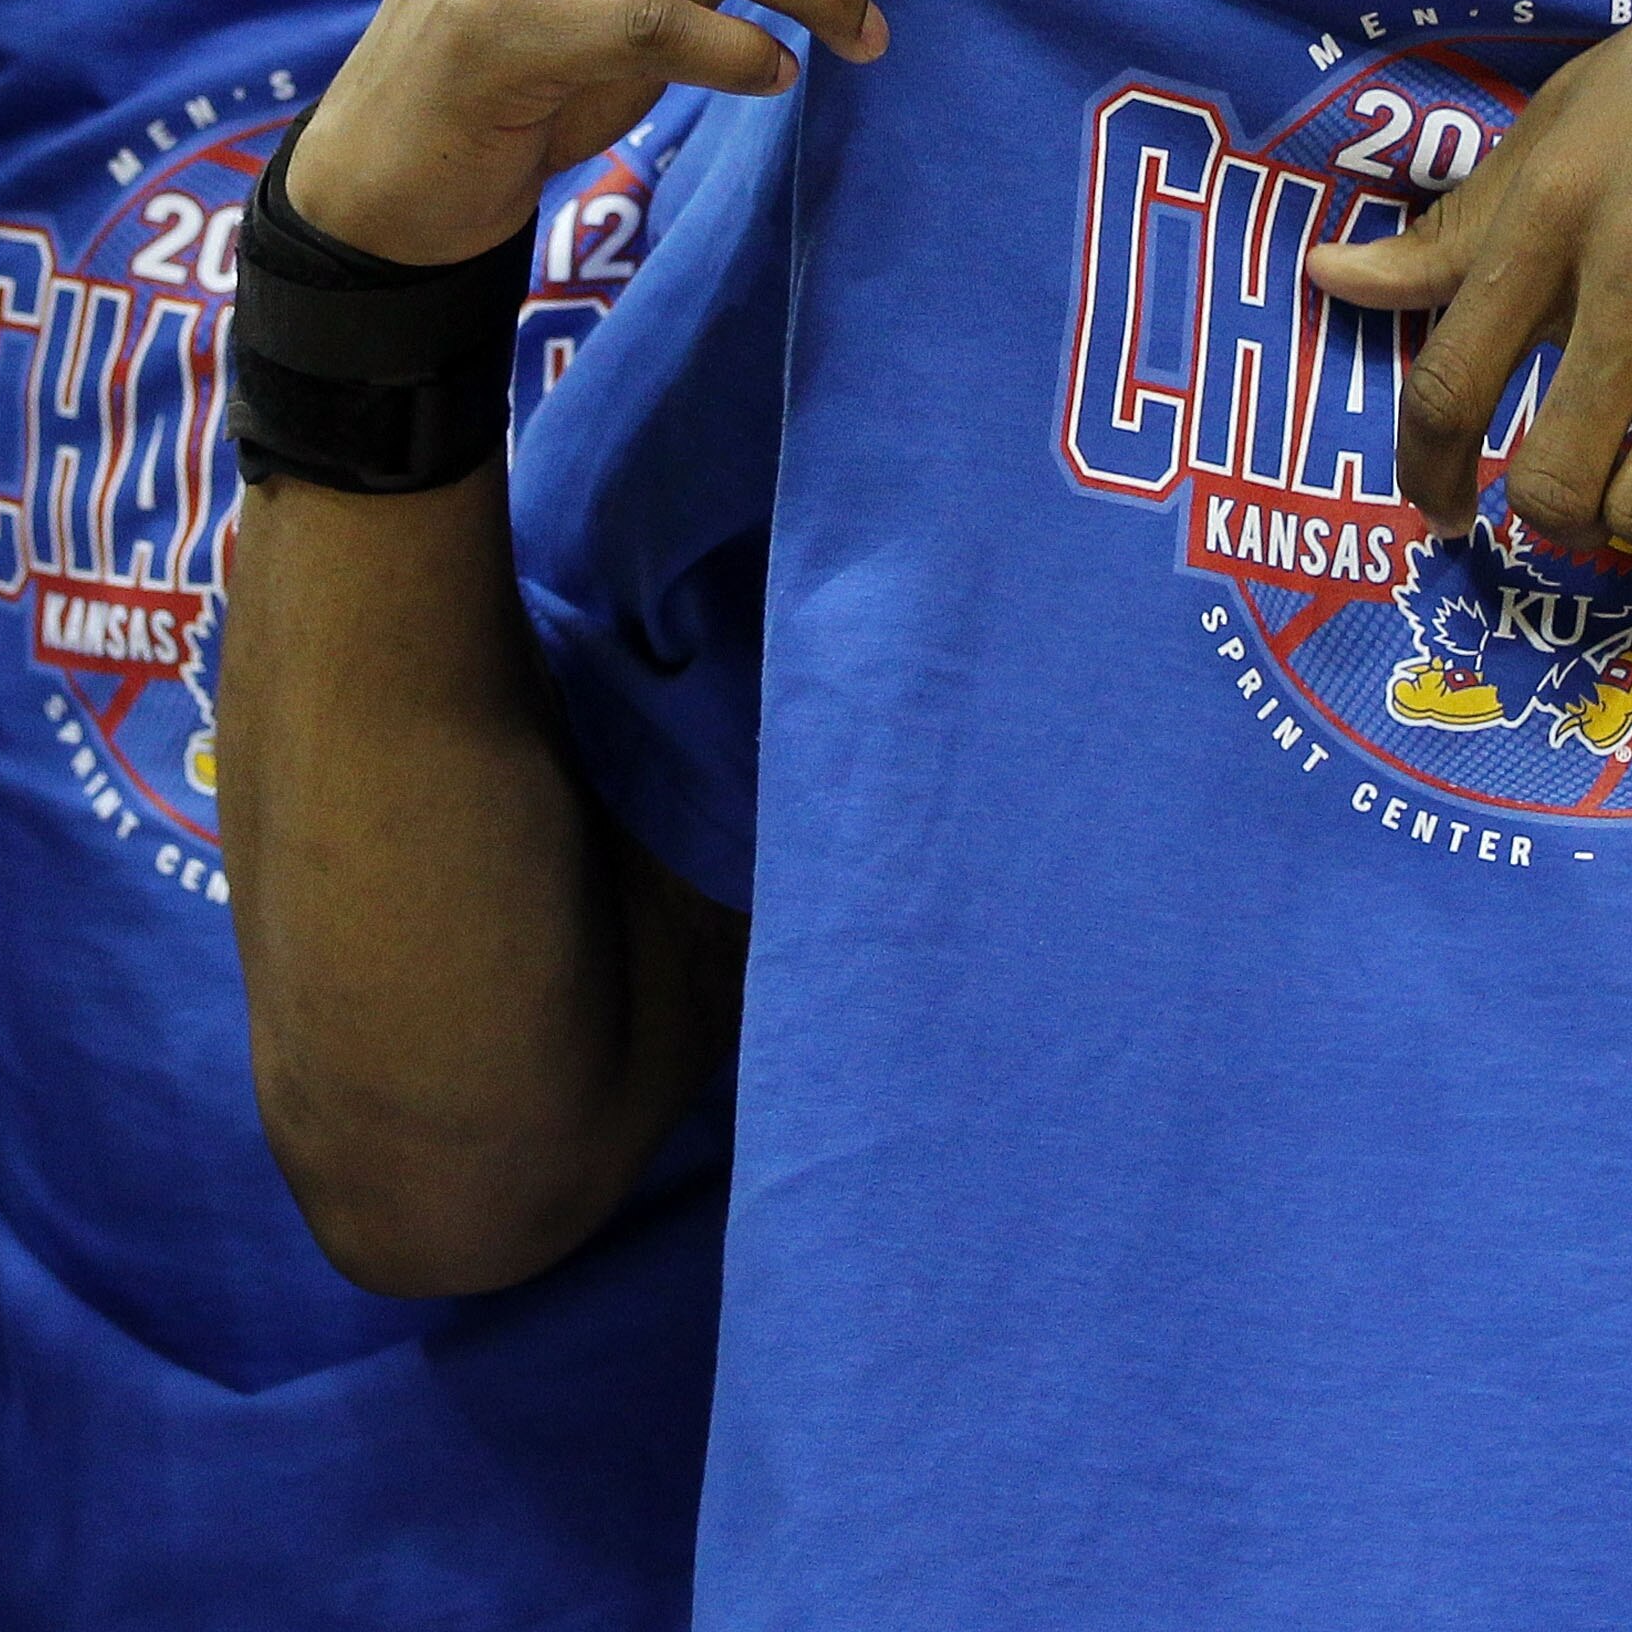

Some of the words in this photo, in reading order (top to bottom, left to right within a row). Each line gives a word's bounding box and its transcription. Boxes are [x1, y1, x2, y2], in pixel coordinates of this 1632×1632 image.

[1204, 494, 1395, 584] KANSAS
[39, 589, 180, 665] KANSAS
[1492, 585, 1593, 654] KU
[1199, 603, 1330, 774] SPRINT
[1349, 780, 1534, 868] CENTER
